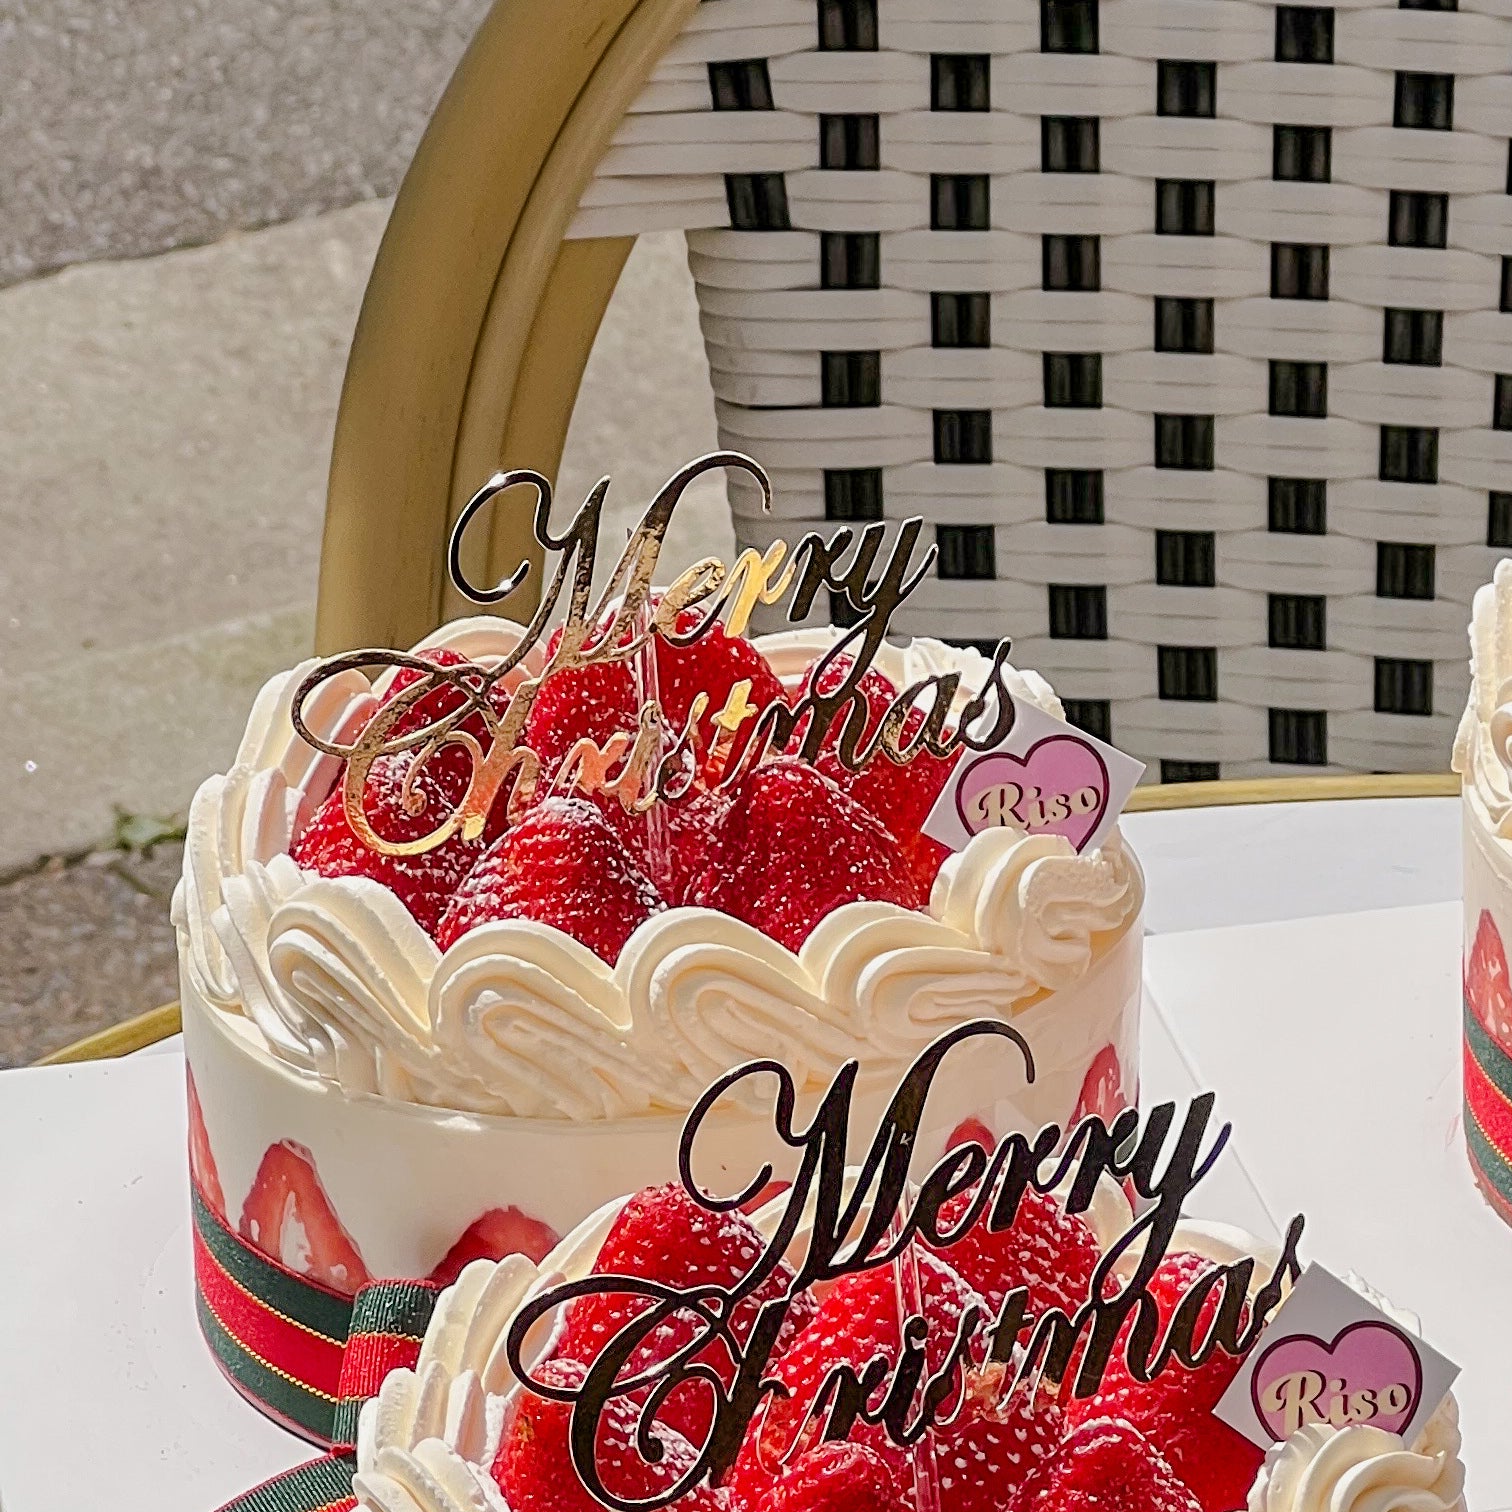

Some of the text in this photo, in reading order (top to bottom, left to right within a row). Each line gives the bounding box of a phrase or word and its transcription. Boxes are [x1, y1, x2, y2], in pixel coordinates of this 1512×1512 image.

[447, 449, 940, 703] Merry
[291, 636, 1015, 857] Christmas
[966, 781, 1101, 831] Riso
[678, 1018, 1232, 1304] Merry
[1260, 1369, 1412, 1440] Riso
